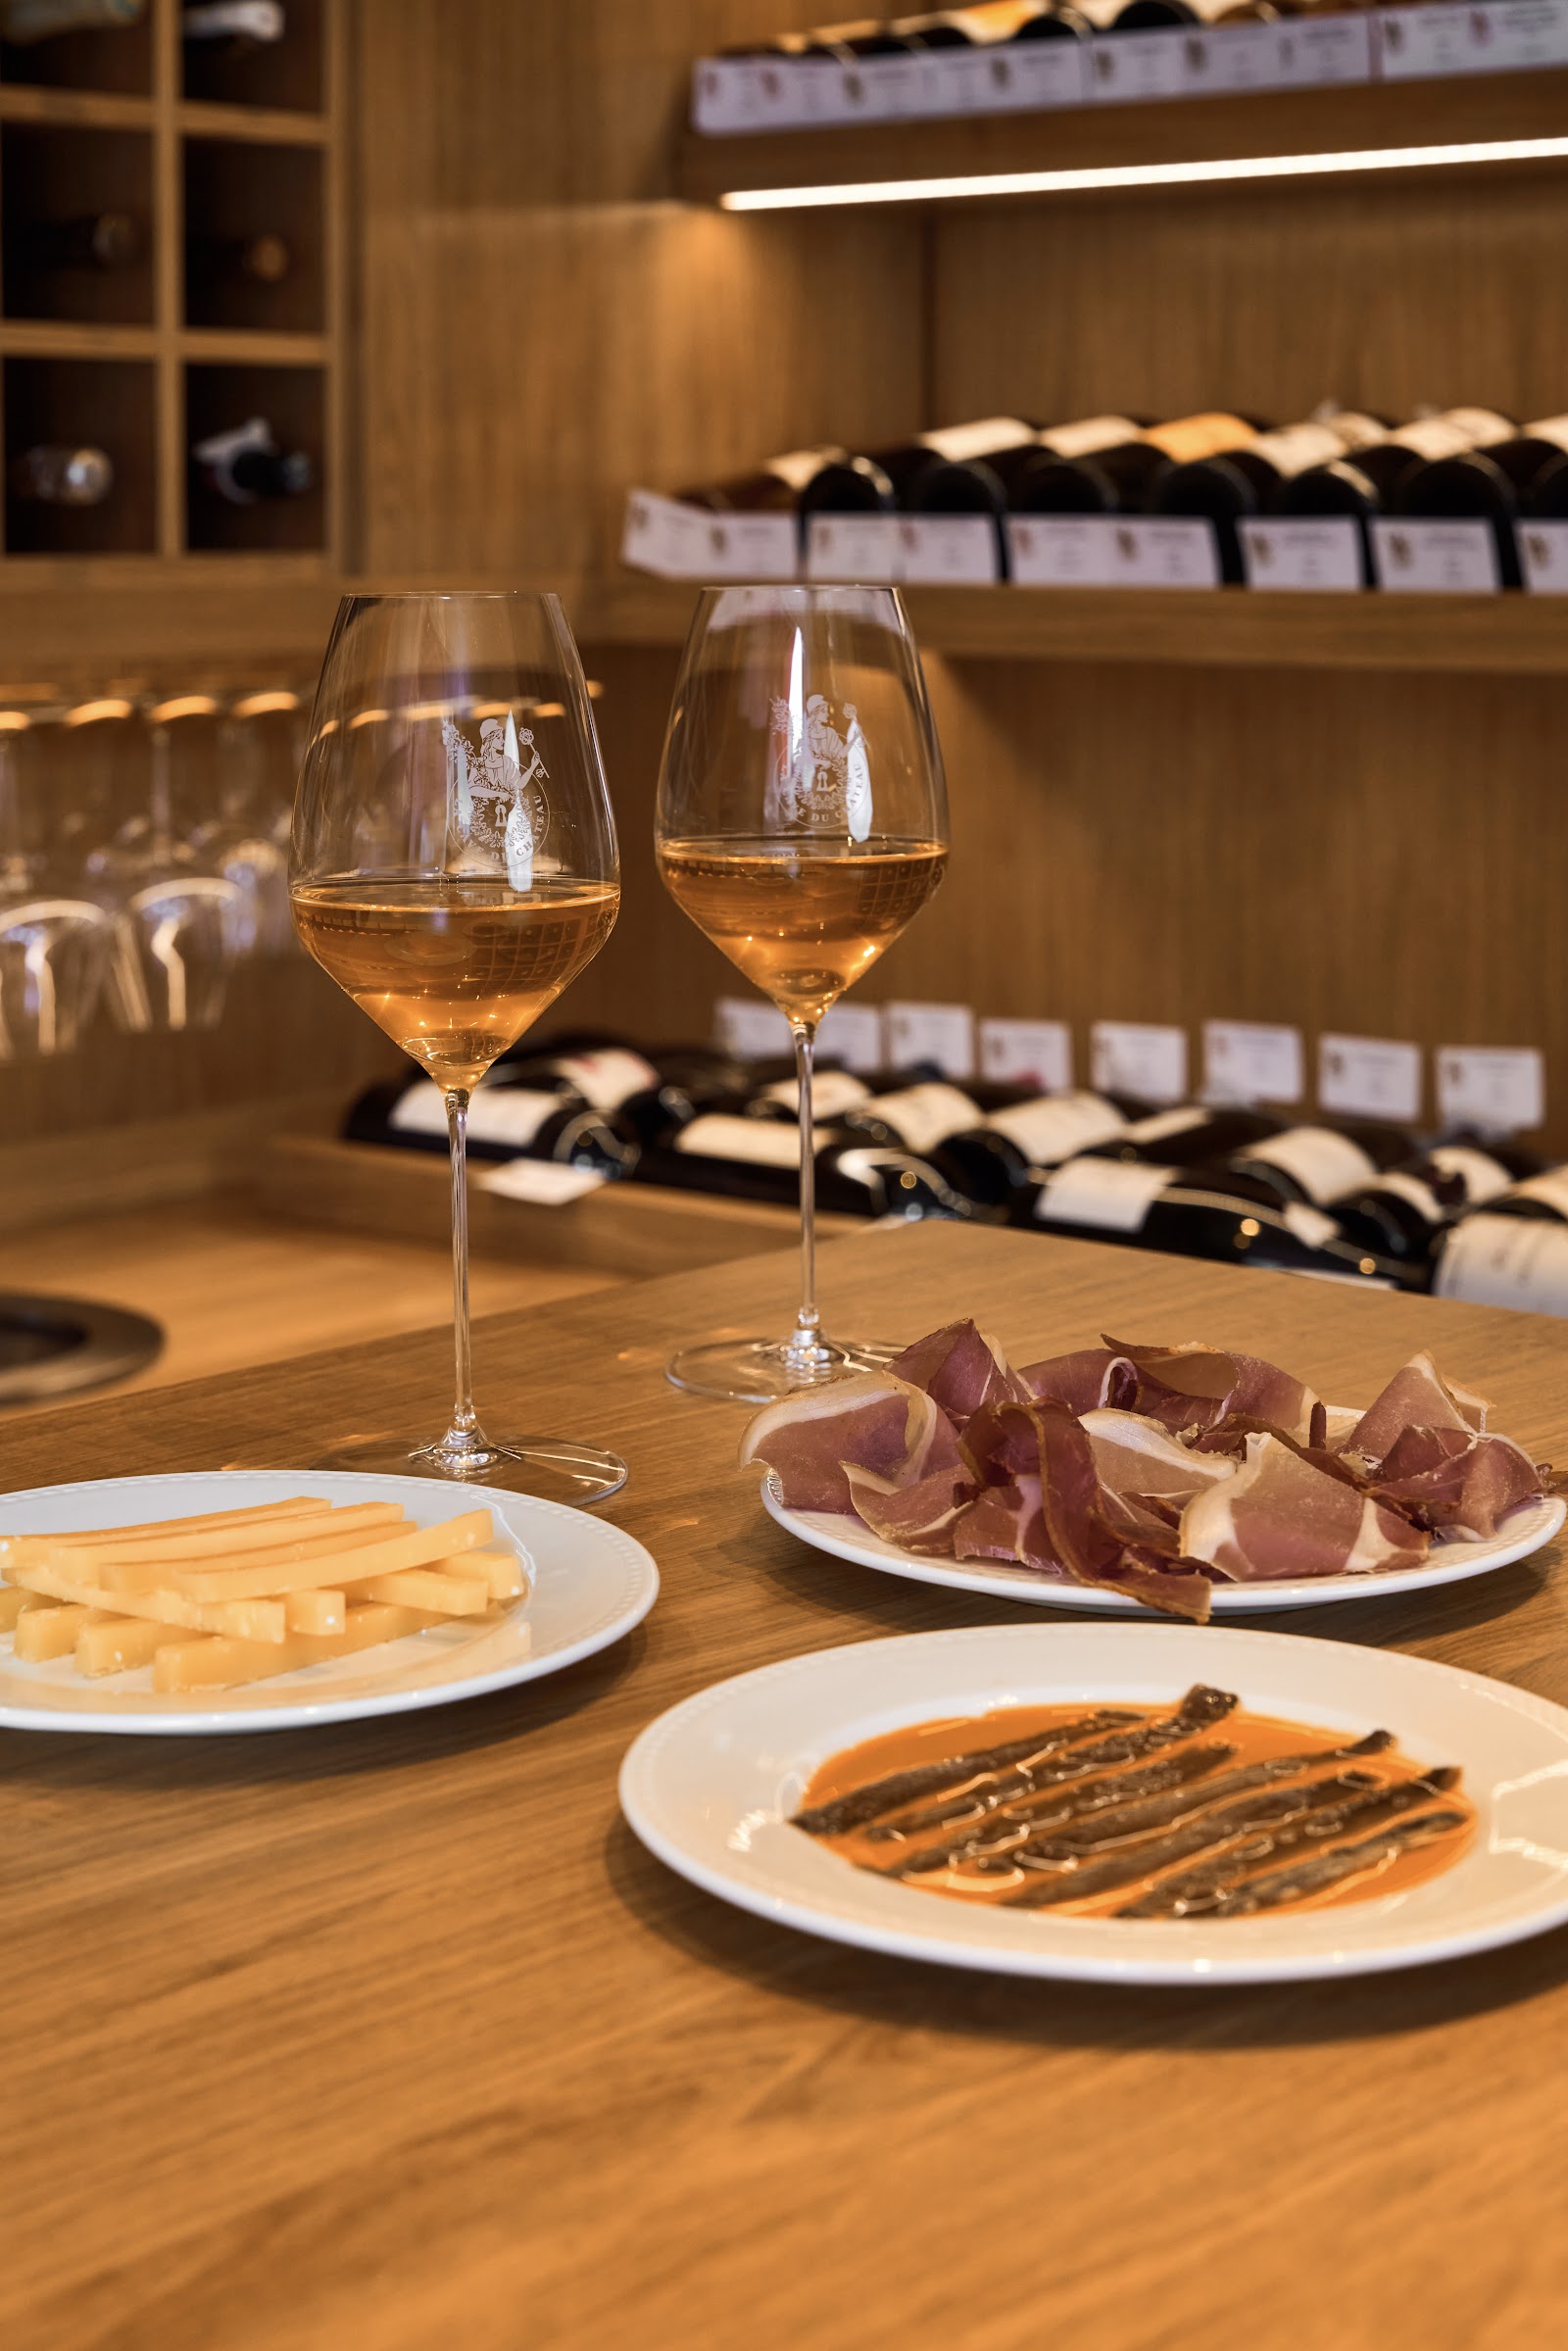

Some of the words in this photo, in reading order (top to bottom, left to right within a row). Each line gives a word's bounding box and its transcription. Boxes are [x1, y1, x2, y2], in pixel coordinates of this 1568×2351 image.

[811, 813, 830, 822] DU
[457, 823, 484, 855] CAVE
[491, 852, 509, 861] DU
